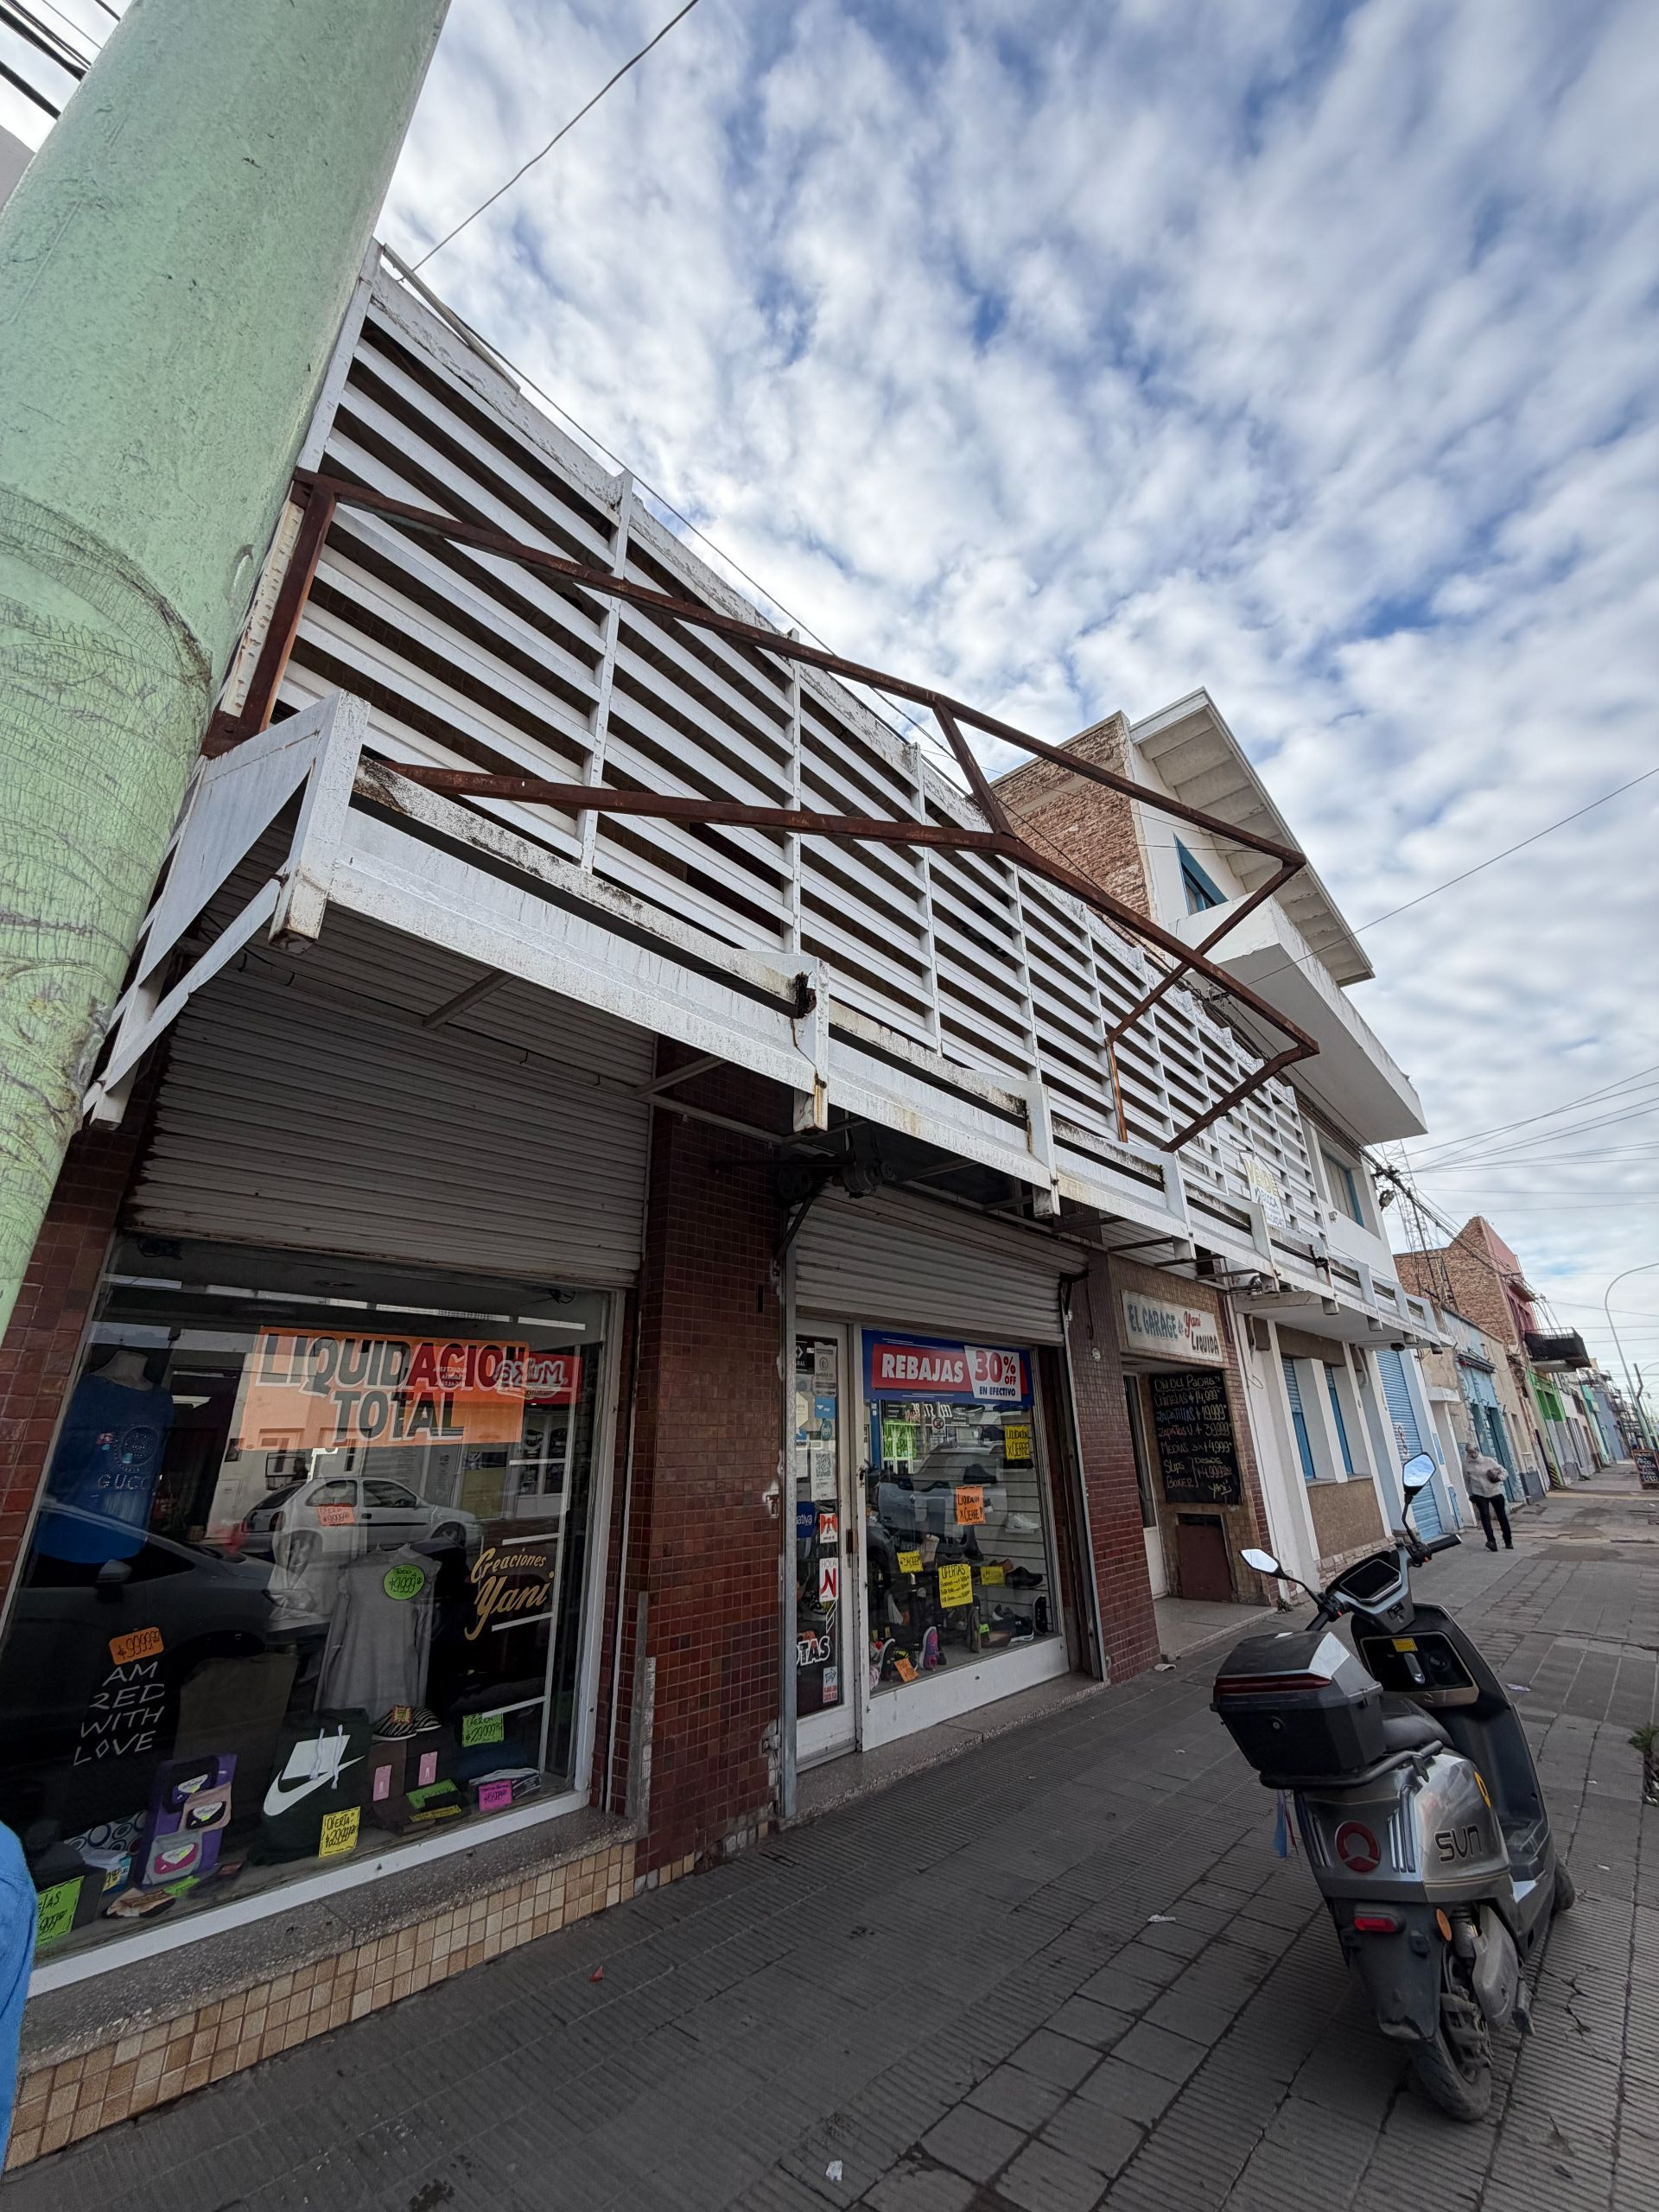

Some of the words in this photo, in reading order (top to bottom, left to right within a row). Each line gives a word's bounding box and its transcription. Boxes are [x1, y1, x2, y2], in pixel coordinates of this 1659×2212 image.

[1127, 1304, 1141, 1332] EL
[1142, 1306, 1178, 1339] GARAGE
[1192, 1331, 1220, 1355] LIQUIDA
[881, 1353, 964, 1383] REBAJAS
[1004, 1376, 1017, 1385] OFF
[979, 1386, 988, 1395] EN
[989, 1386, 1016, 1397] EFECTIVO
[333, 1390, 465, 1444] TOTAL
[797, 1514, 813, 1526] ativa
[470, 1548, 547, 1584] Creaciones
[821, 1559, 837, 1568] HOLA
[464, 1571, 555, 1641] Yani
[80, 1706, 165, 1738] WITH
[73, 1730, 156, 1767] LOVE
